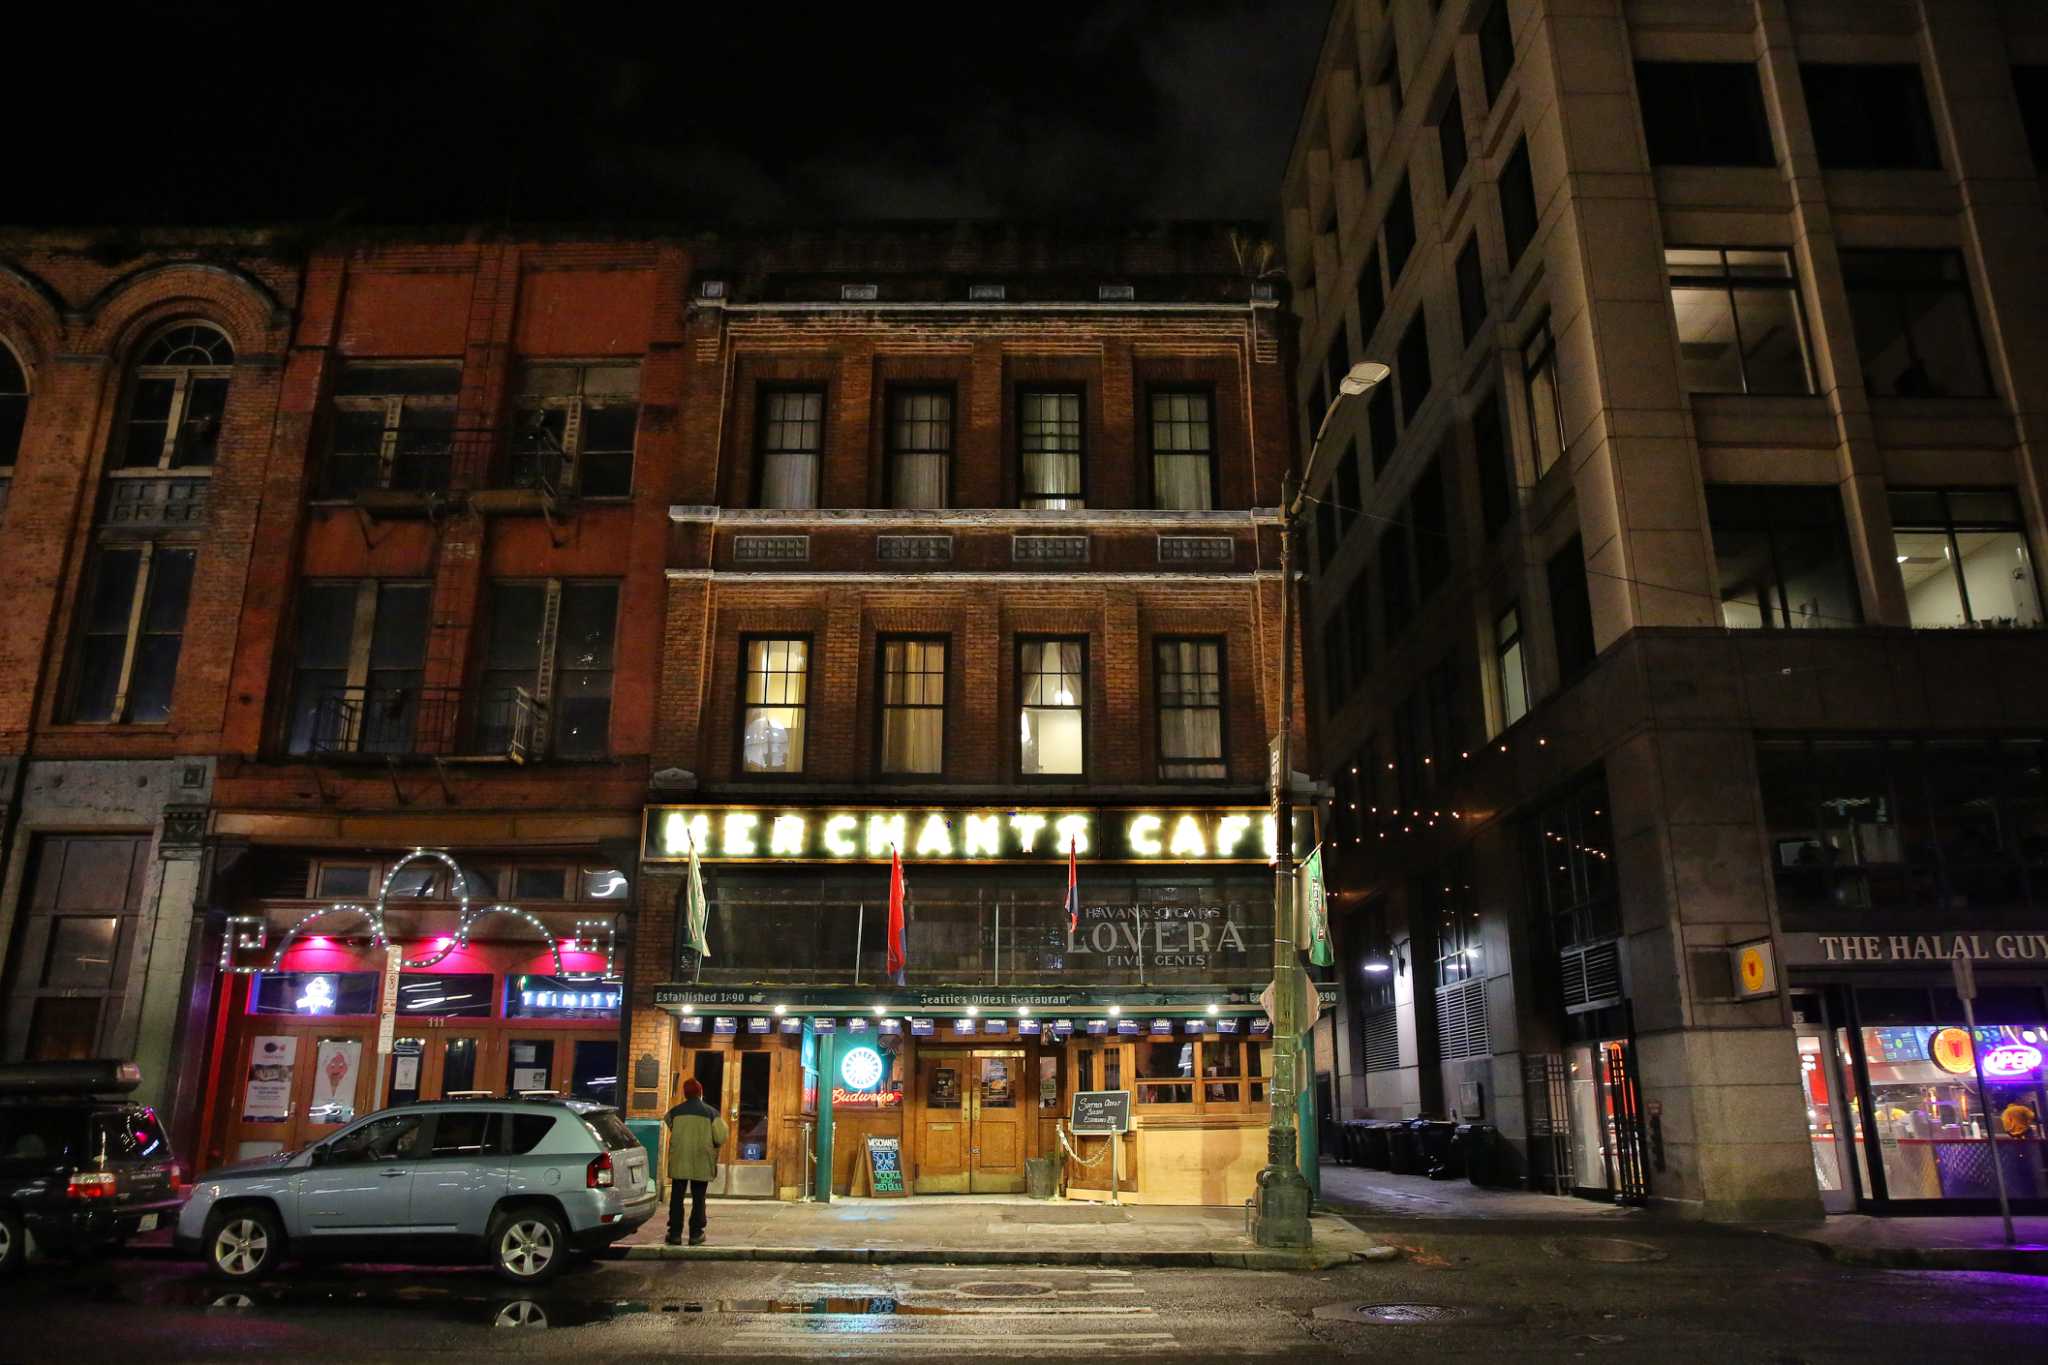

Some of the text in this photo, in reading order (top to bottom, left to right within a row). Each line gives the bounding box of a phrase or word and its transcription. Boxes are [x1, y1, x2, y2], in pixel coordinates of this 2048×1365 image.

[664, 812, 1090, 856] MERCHANTS
[1086, 907, 1147, 919] HAVANA
[1067, 921, 1247, 953] LOVERA
[1819, 936, 1882, 961] THE
[1889, 935, 1990, 960] HALAL
[1107, 955, 1145, 967] FIVE
[521, 991, 617, 1008] TRINITY
[656, 991, 717, 1002] Established
[972, 992, 1006, 1004] Oldest
[1987, 1050, 2037, 1070] OPEN
